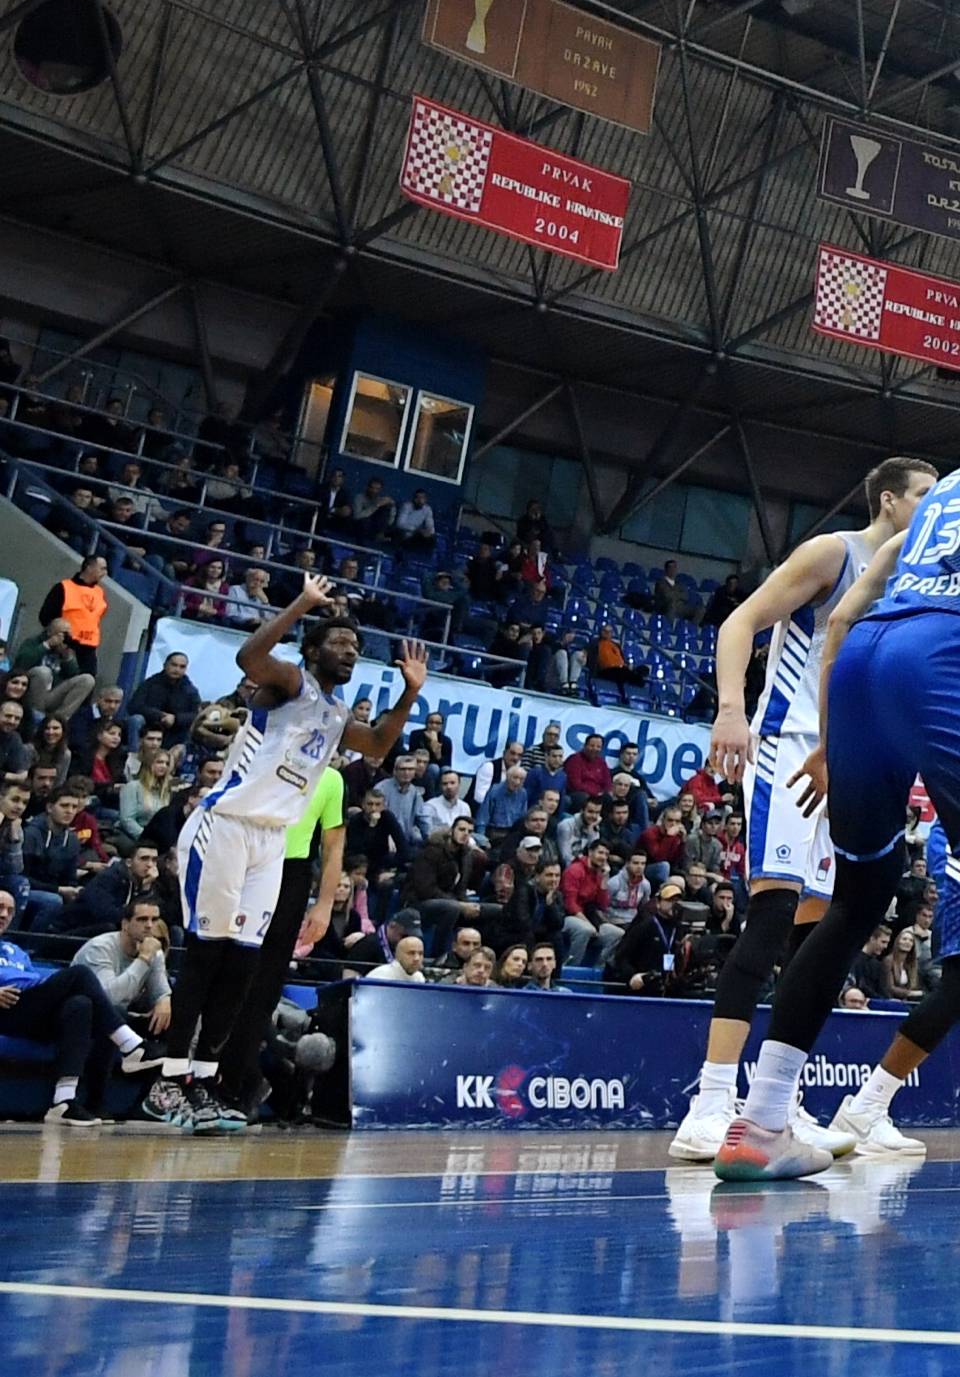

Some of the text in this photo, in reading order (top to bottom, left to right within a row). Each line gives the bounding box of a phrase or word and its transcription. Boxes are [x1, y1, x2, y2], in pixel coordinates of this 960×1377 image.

[542, 163, 592, 192] PRVAK
[492, 173, 624, 228] REPUBLIKE HRVATSKE
[534, 218, 579, 244] 2004
[884, 300, 945, 326] REPUBLIKE
[923, 335, 960, 355] 2002
[301, 728, 325, 759] 23
[456, 1075, 625, 1109] KK CIBONA
